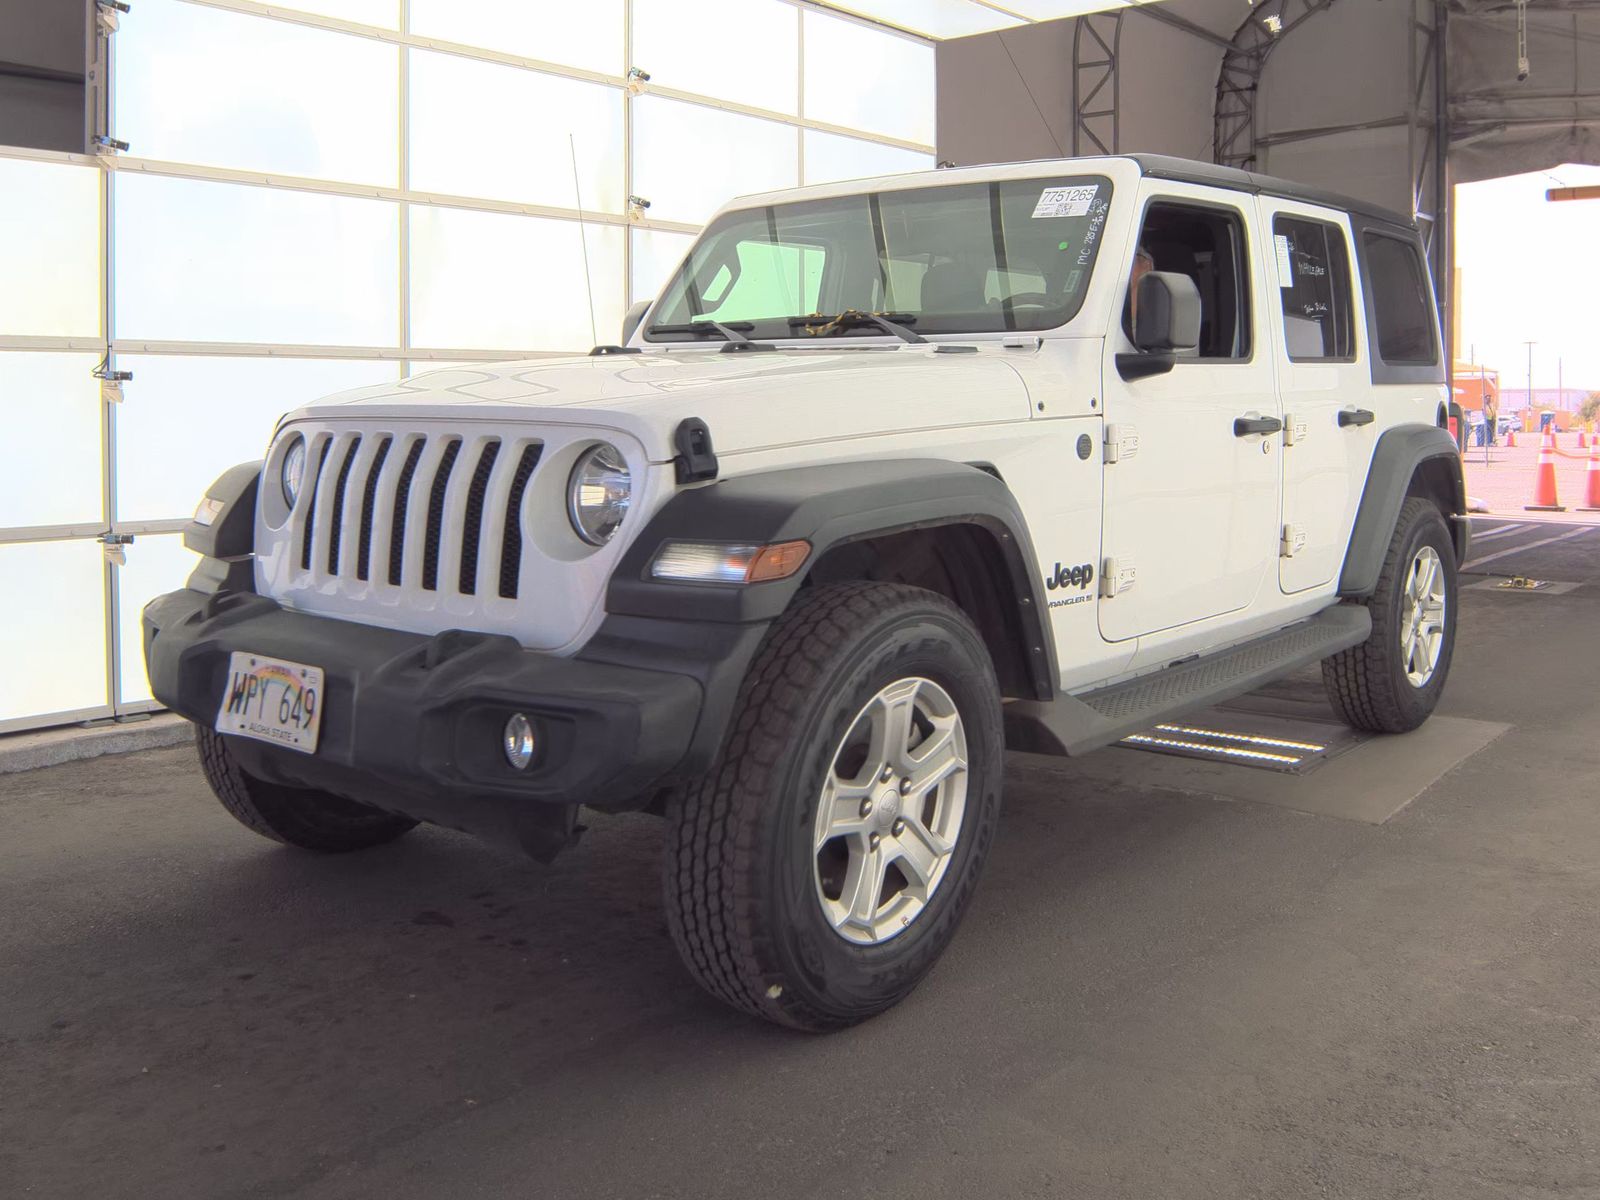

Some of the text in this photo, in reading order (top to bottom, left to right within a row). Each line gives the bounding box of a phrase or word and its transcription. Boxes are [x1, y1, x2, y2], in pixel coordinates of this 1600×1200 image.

[1041, 188, 1096, 203] 7751265
[1046, 562, 1094, 590] Jeep
[227, 671, 316, 729] WPY 649
